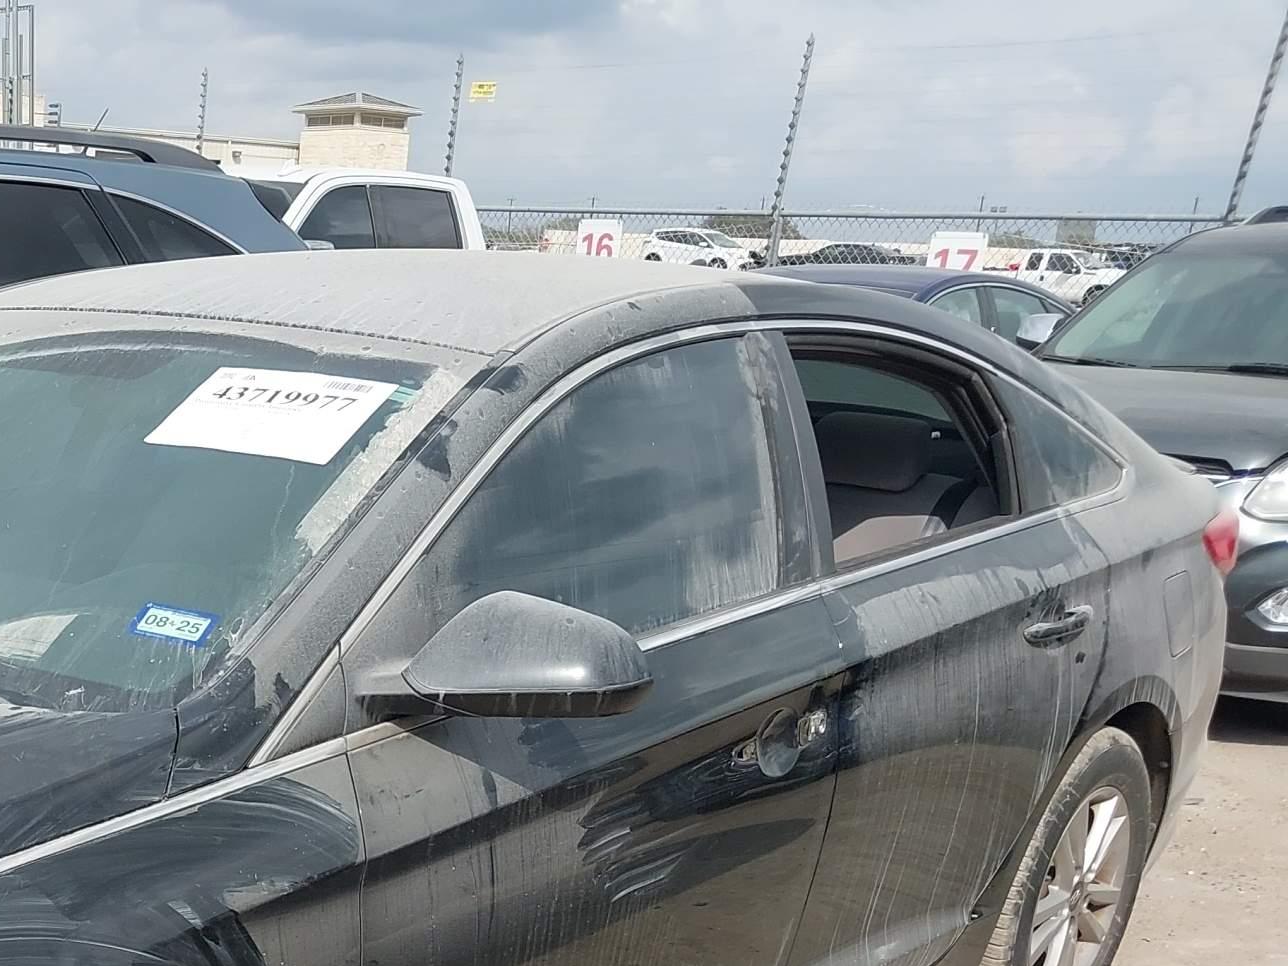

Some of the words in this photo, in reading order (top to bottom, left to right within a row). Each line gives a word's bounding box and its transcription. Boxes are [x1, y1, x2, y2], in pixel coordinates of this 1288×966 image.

[582, 232, 614, 257] 16
[934, 248, 978, 271] 17
[212, 385, 359, 411] 43719977
